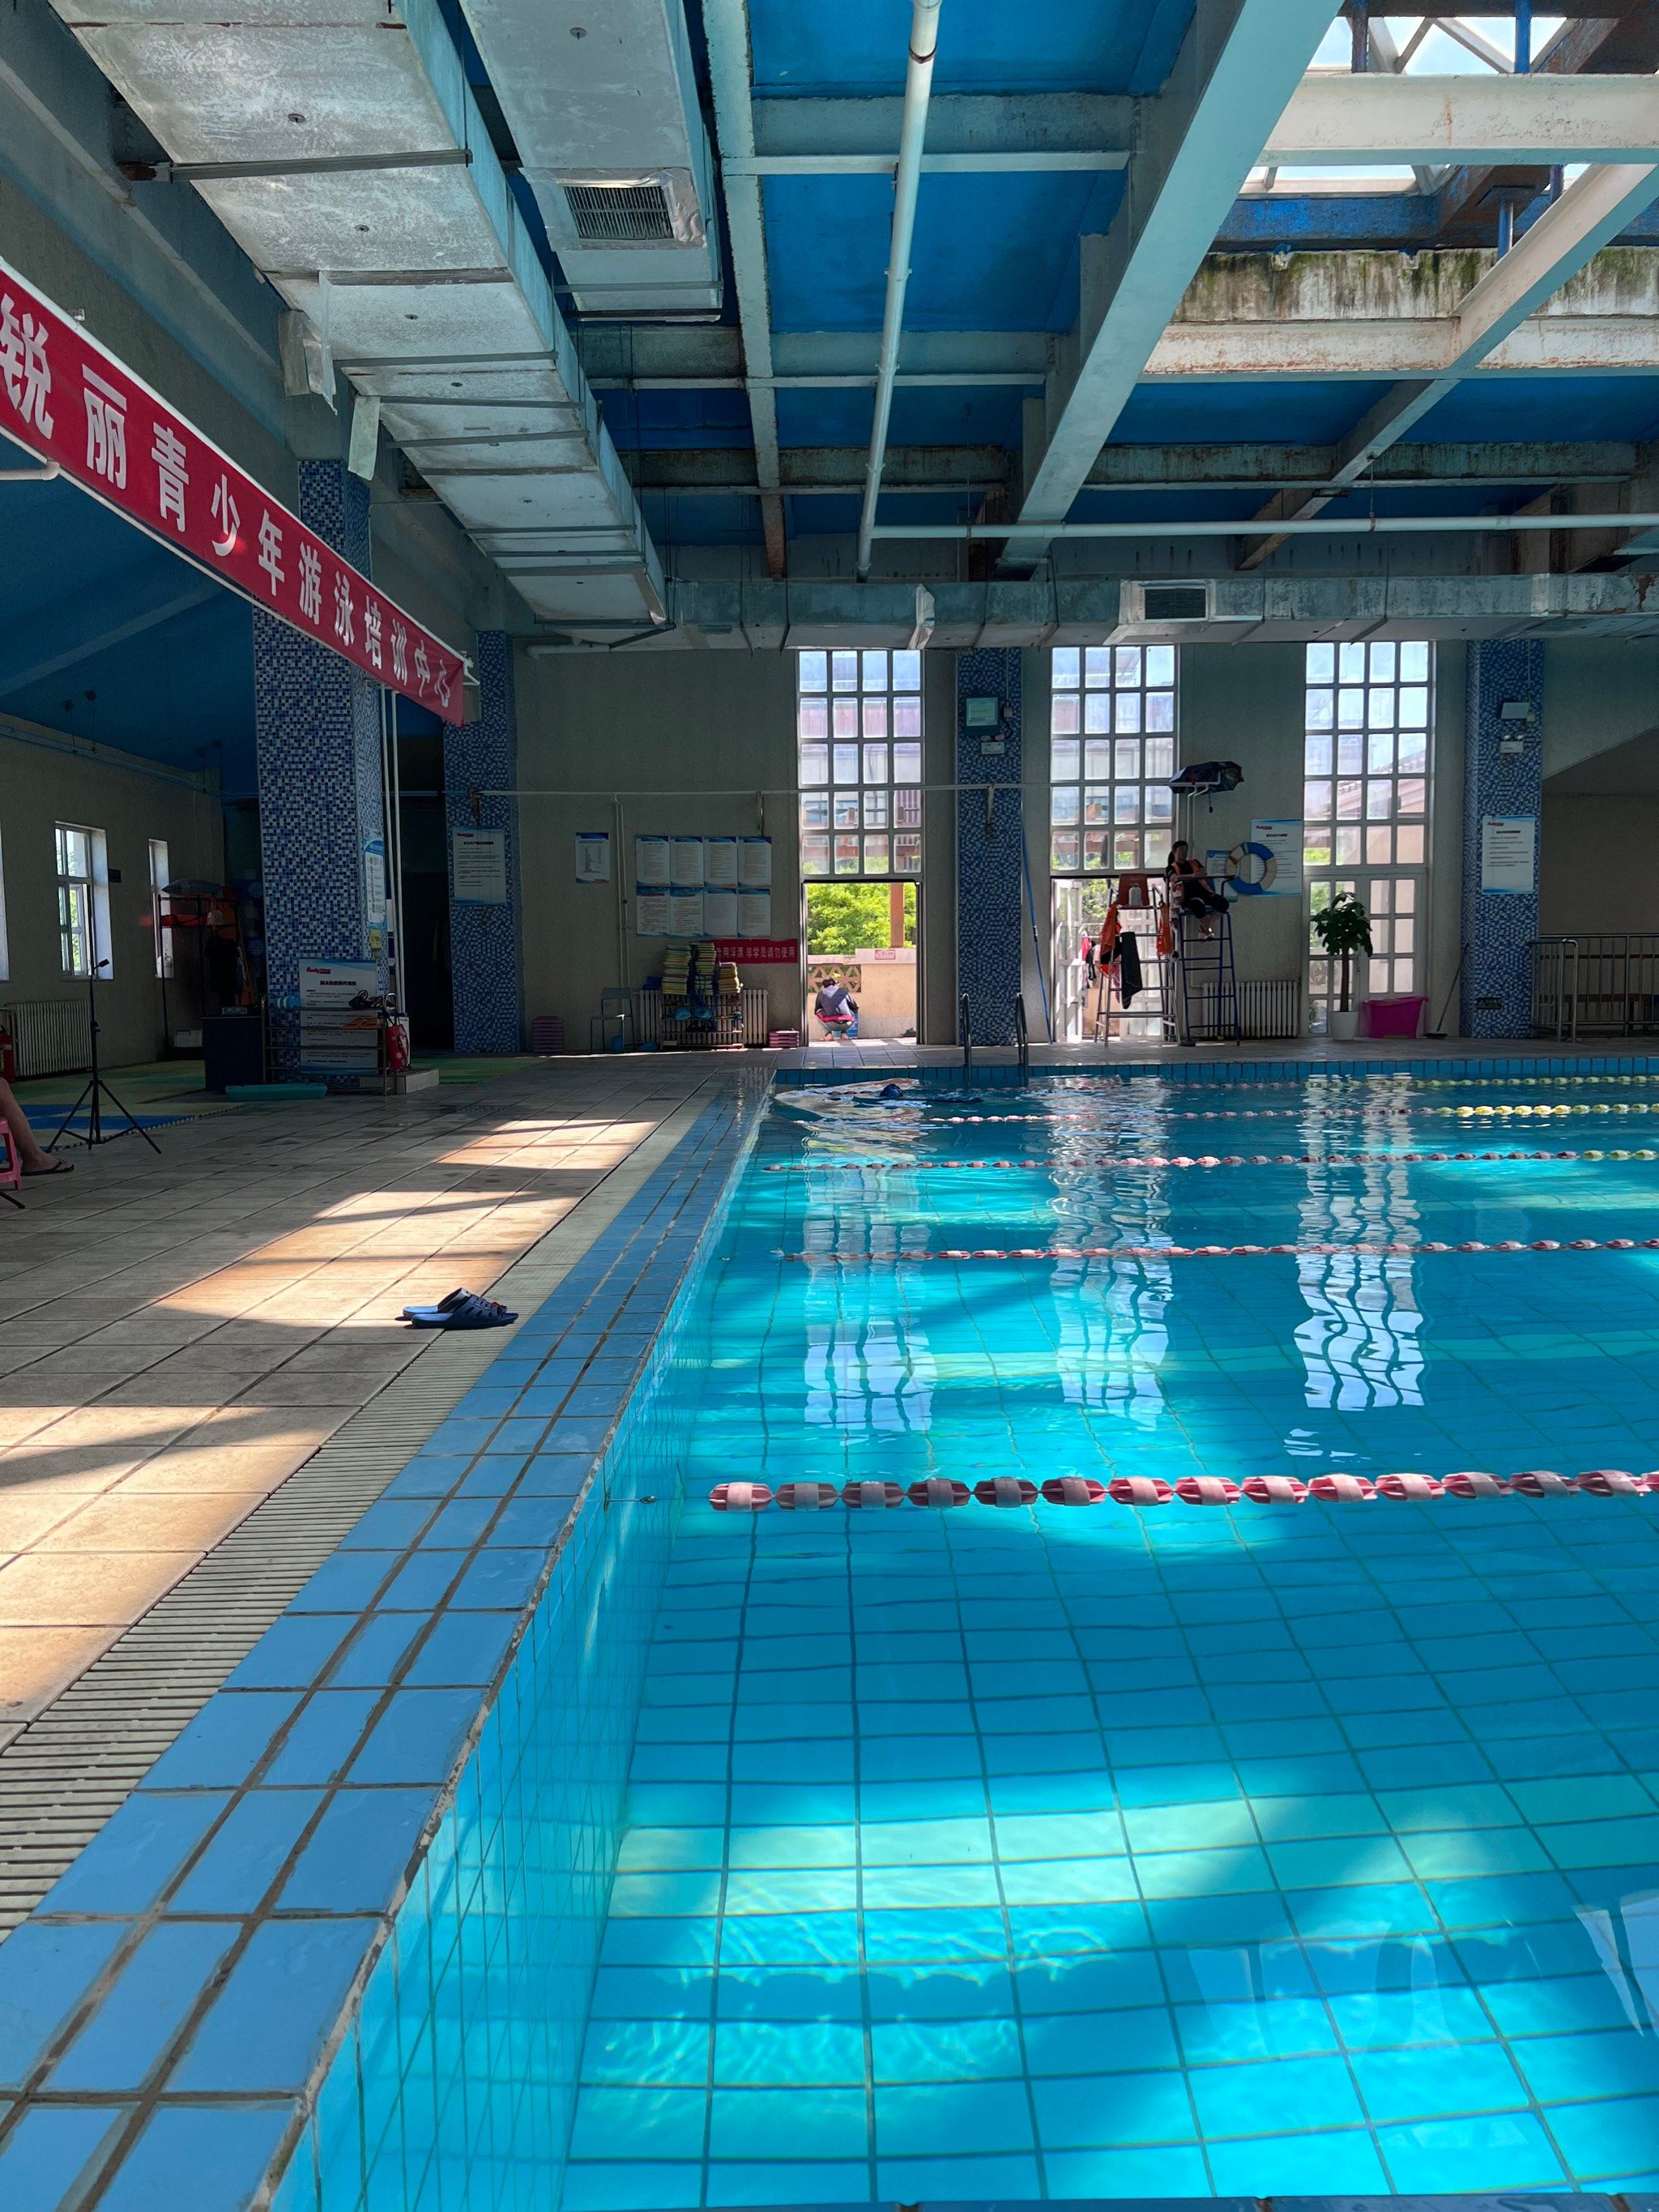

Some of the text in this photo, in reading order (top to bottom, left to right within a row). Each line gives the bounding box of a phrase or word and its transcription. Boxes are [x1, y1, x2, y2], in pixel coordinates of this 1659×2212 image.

[0, 293, 450, 707] 锐丽青少年游泳培训中心
